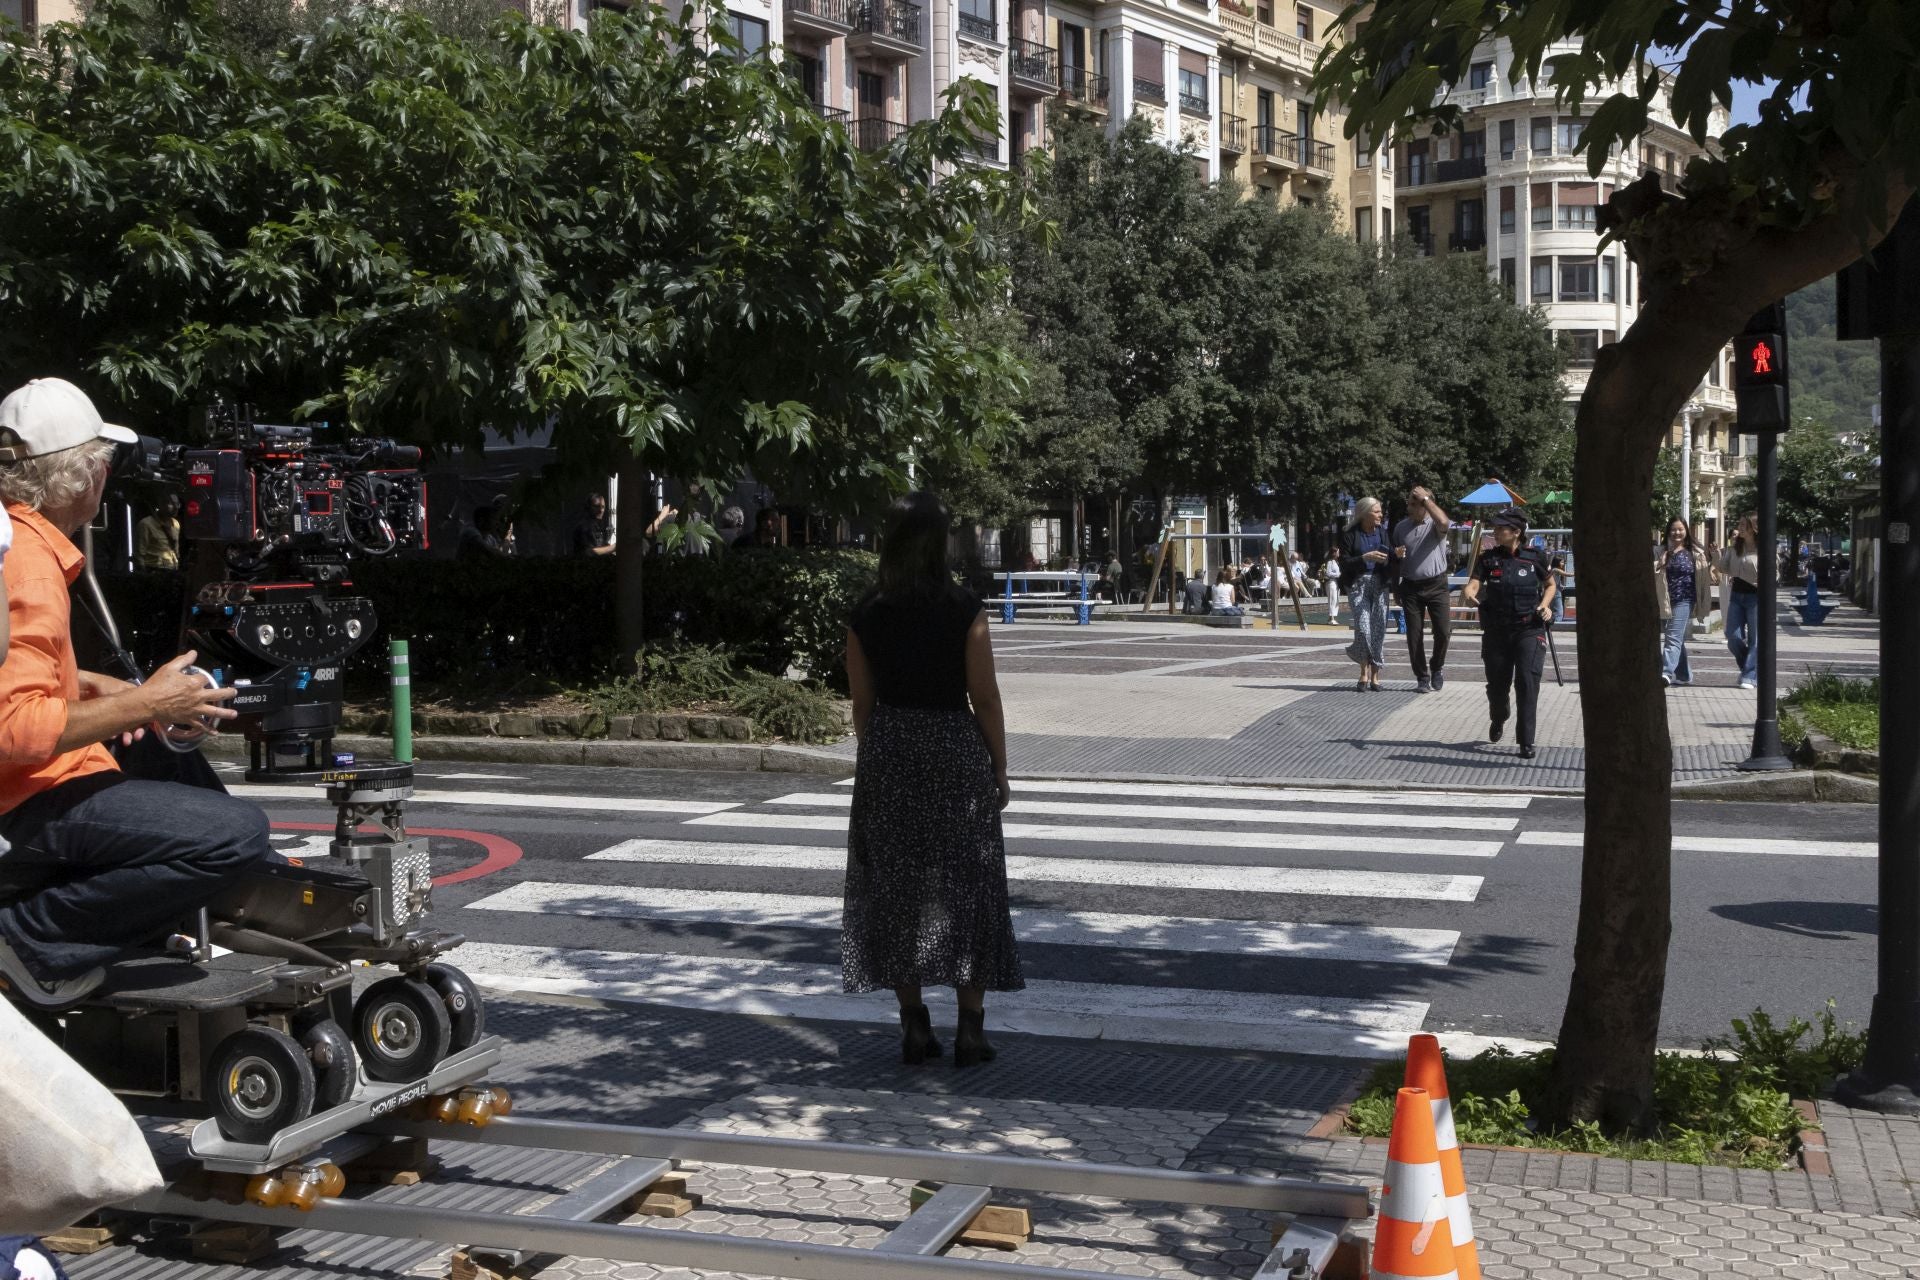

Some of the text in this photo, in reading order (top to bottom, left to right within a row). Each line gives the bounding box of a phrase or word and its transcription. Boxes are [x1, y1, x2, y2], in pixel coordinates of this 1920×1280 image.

[314, 668, 335, 680] ARRI
[371, 1084, 426, 1116] MOVIE PEOPLE
